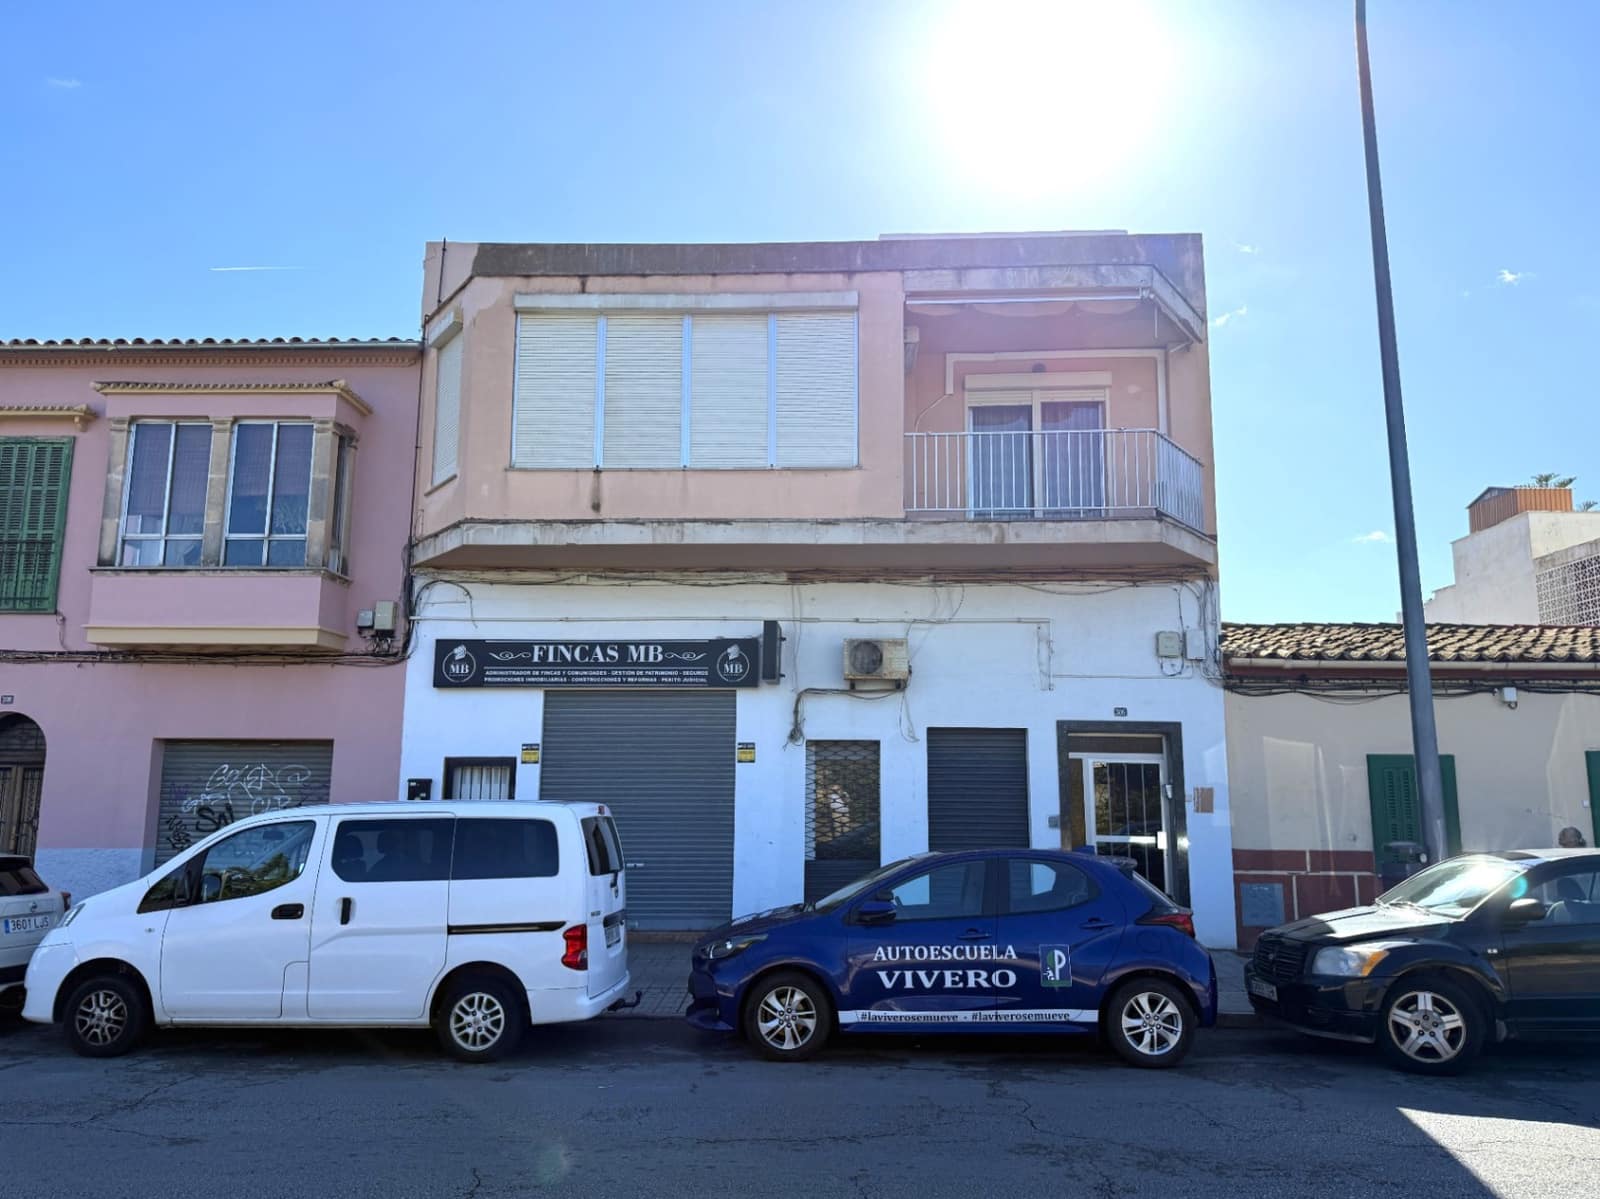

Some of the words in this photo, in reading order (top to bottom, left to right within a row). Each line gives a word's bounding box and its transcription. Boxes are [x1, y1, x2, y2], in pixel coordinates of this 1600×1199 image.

[532, 645, 619, 662] FINCAS
[627, 645, 664, 662] MB
[449, 664, 470, 674] MB
[723, 663, 744, 674] MB
[10, 919, 32, 931] 3601
[873, 945, 1018, 961] AUTOESCUELA
[877, 969, 1017, 989] VIVERO
[860, 1012, 959, 1022] #laviverosemueve
[971, 1011, 1070, 1021] #laviverosemueve
